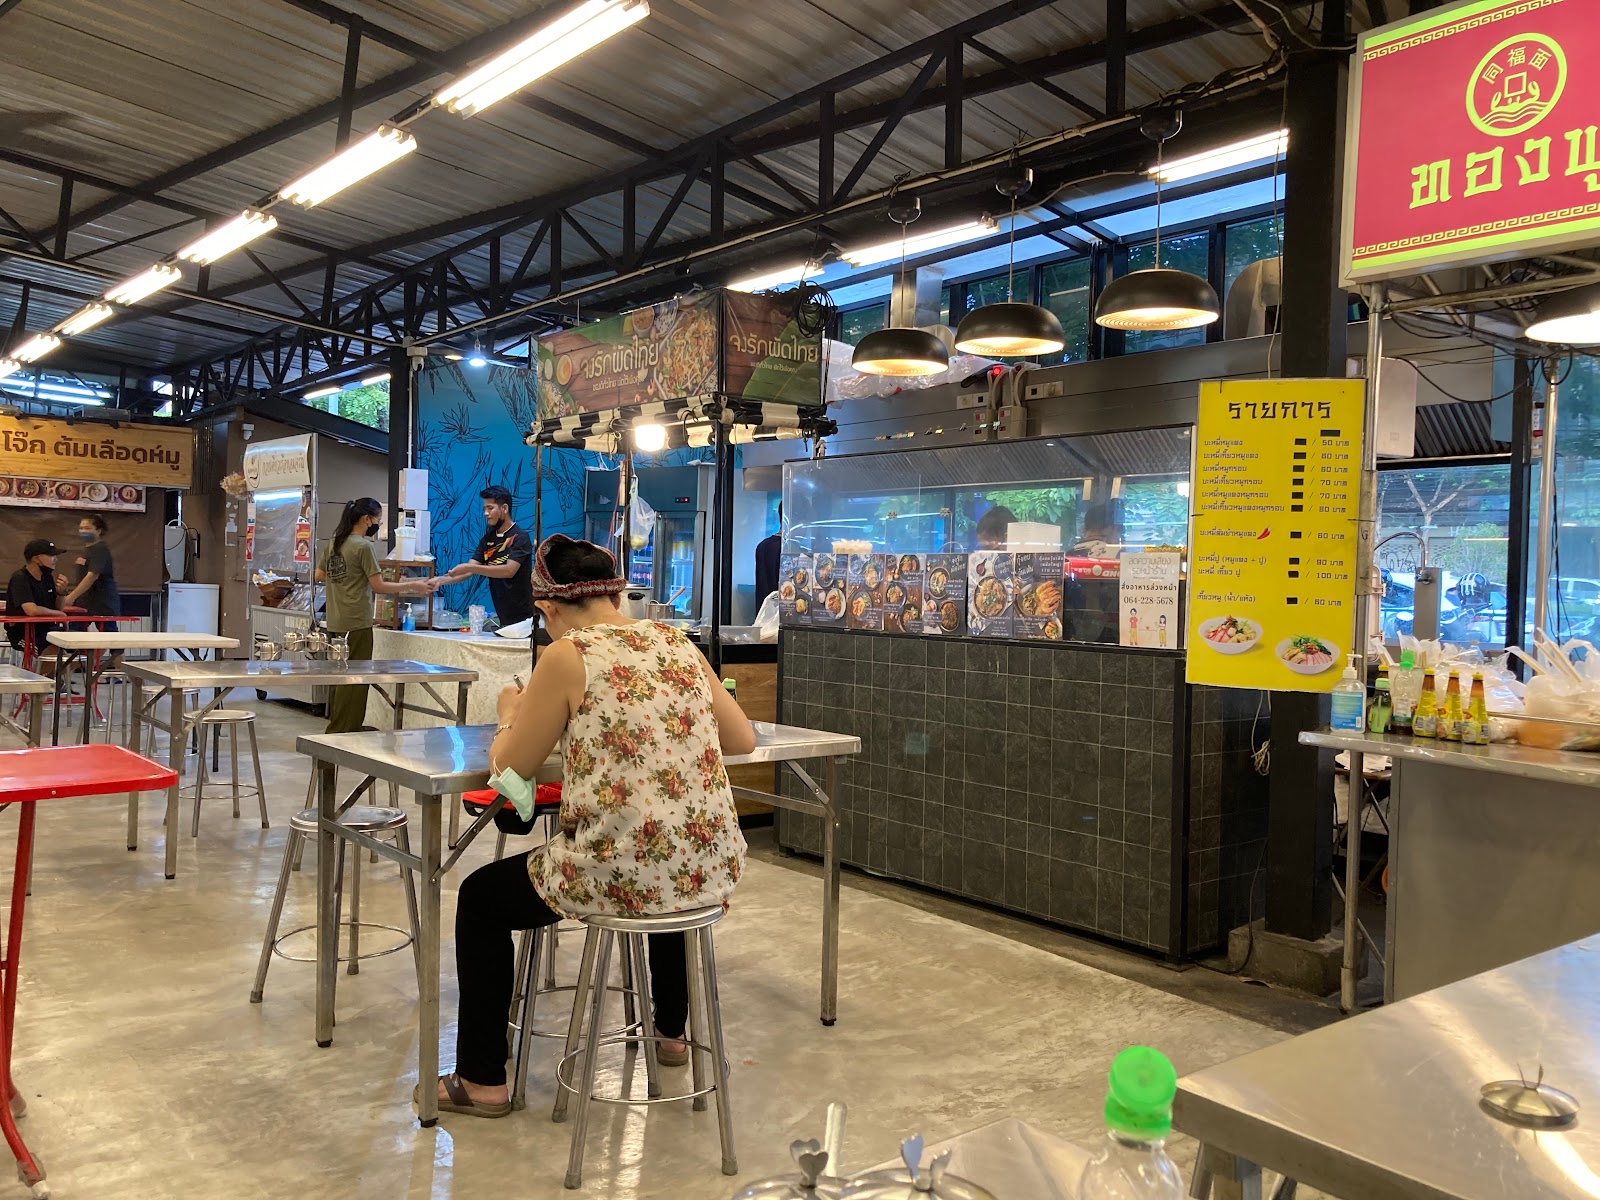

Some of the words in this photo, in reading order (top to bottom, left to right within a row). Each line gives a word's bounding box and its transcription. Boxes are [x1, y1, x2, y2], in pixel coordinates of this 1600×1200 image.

[1482, 46, 1552, 84] 同福面
[581, 334, 659, 379] จงรักผัดไทย
[730, 332, 818, 362] จงรักผัดไทย
[1228, 401, 1331, 419] รายการ
[2, 430, 46, 454] โจ๊ก
[54, 435, 180, 470] ต้มเลือดหมู
[1121, 582, 1177, 591] สั่งอาหารล่วงหน้า
[1124, 596, 1173, 605] 064-228-5678
